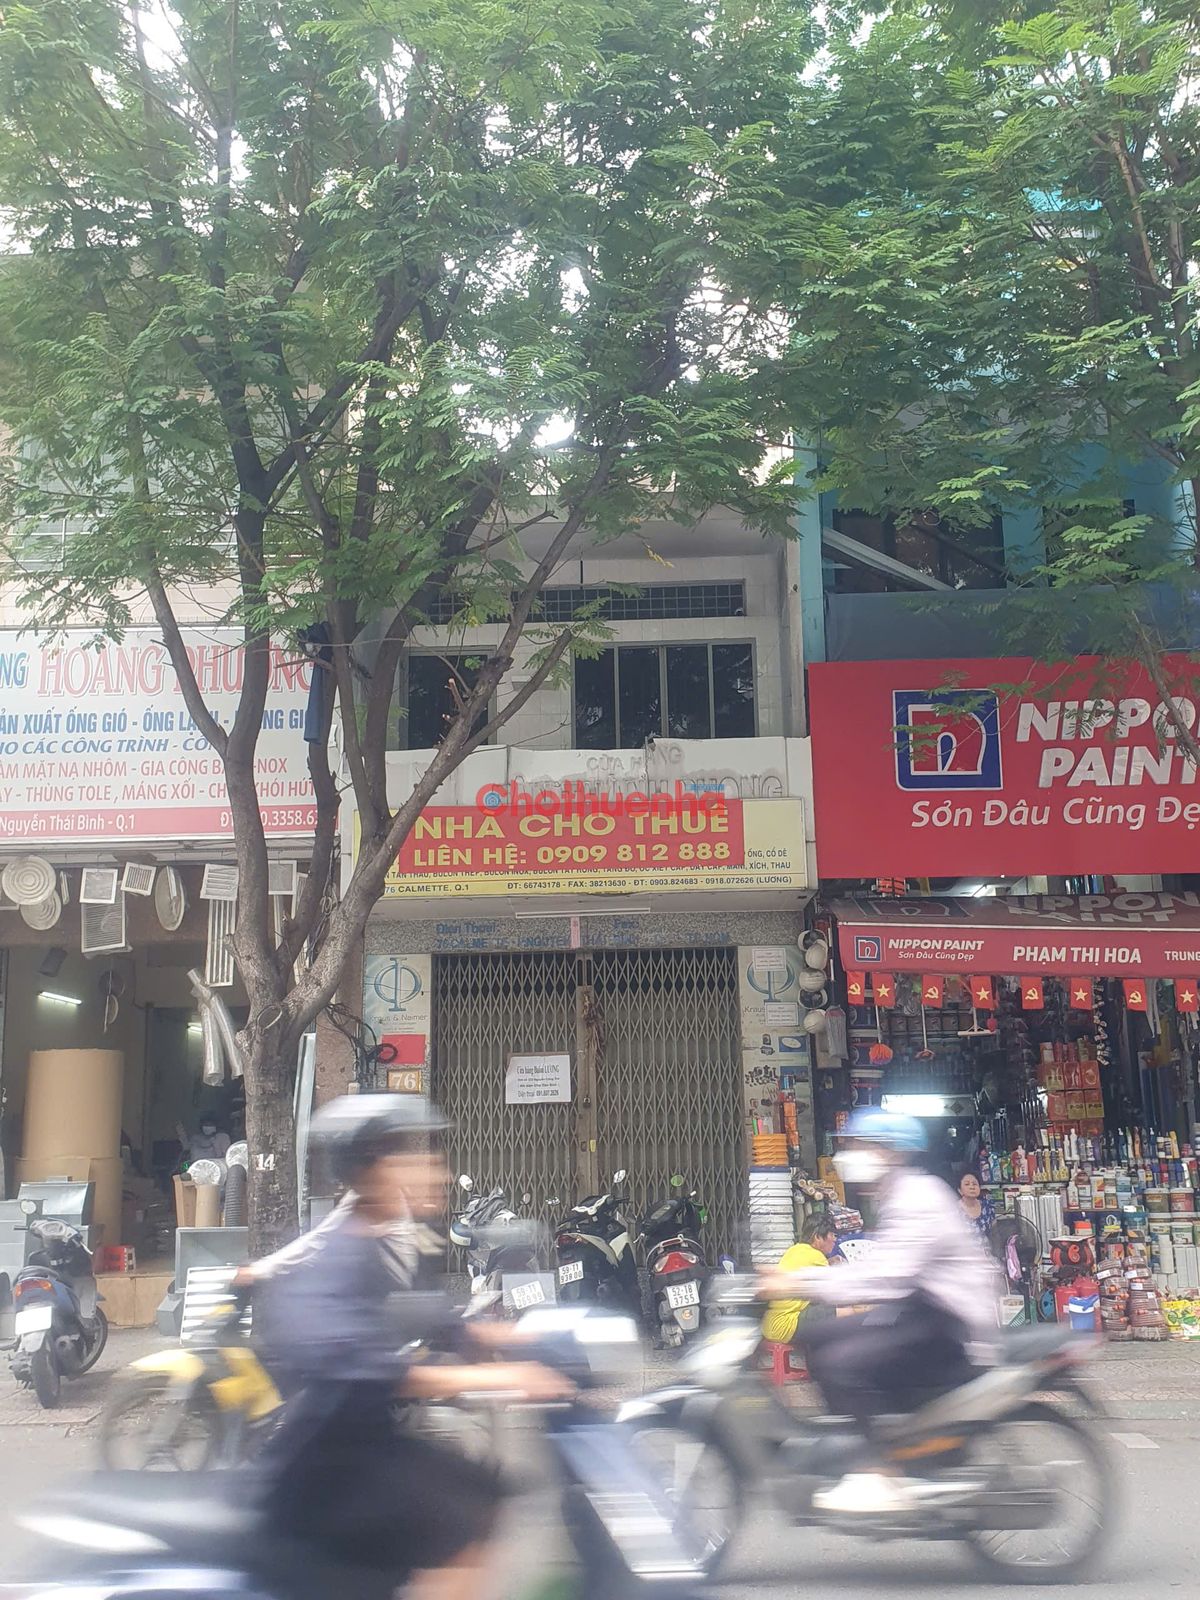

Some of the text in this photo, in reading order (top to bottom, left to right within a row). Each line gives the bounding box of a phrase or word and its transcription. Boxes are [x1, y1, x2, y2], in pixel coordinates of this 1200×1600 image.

[22, 706, 62, 734] XUẤT
[65, 706, 97, 733] ỐNG
[102, 708, 127, 733] GIÓ
[142, 705, 174, 732] ỐNG
[289, 709, 307, 730] GI
[1016, 696, 1200, 742] NIPPO
[22, 738, 58, 755] CÁC
[62, 737, 112, 754] CÔNG
[117, 736, 169, 752] TRÌNH
[23, 760, 55, 781] MẶT
[58, 761, 79, 781] NẠ
[83, 758, 127, 777] NHÔM
[141, 761, 165, 776] GIA
[169, 757, 208, 776] CÔNG
[26, 782, 74, 802] THÙNG
[78, 785, 111, 801] TOLE
[122, 781, 168, 800] MÁNG
[171, 778, 195, 799] XỐI
[519, 814, 615, 838] CHO
[632, 803, 730, 834] THUÊ
[981, 799, 1051, 826] Đâu
[1063, 797, 1146, 830] Cũng
[0, 814, 46, 836] Nguyễn
[50, 814, 74, 831] Thái
[78, 814, 105, 831] Bình
[116, 814, 135, 832] Q.1
[414, 841, 731, 869] LIÊN HỆ: 0909 812 888
[770, 861, 791, 869] THAU
[398, 884, 452, 893] CALMETTE,
[568, 880, 588, 888] FAX:
[888, 939, 985, 951] NIPPON PAINT
[1013, 946, 1141, 966] PHẠM THỊ HOA
[393, 1071, 416, 1090] 76
[253, 1153, 275, 1171] 14
[673, 1294, 695, 1307] 3755
